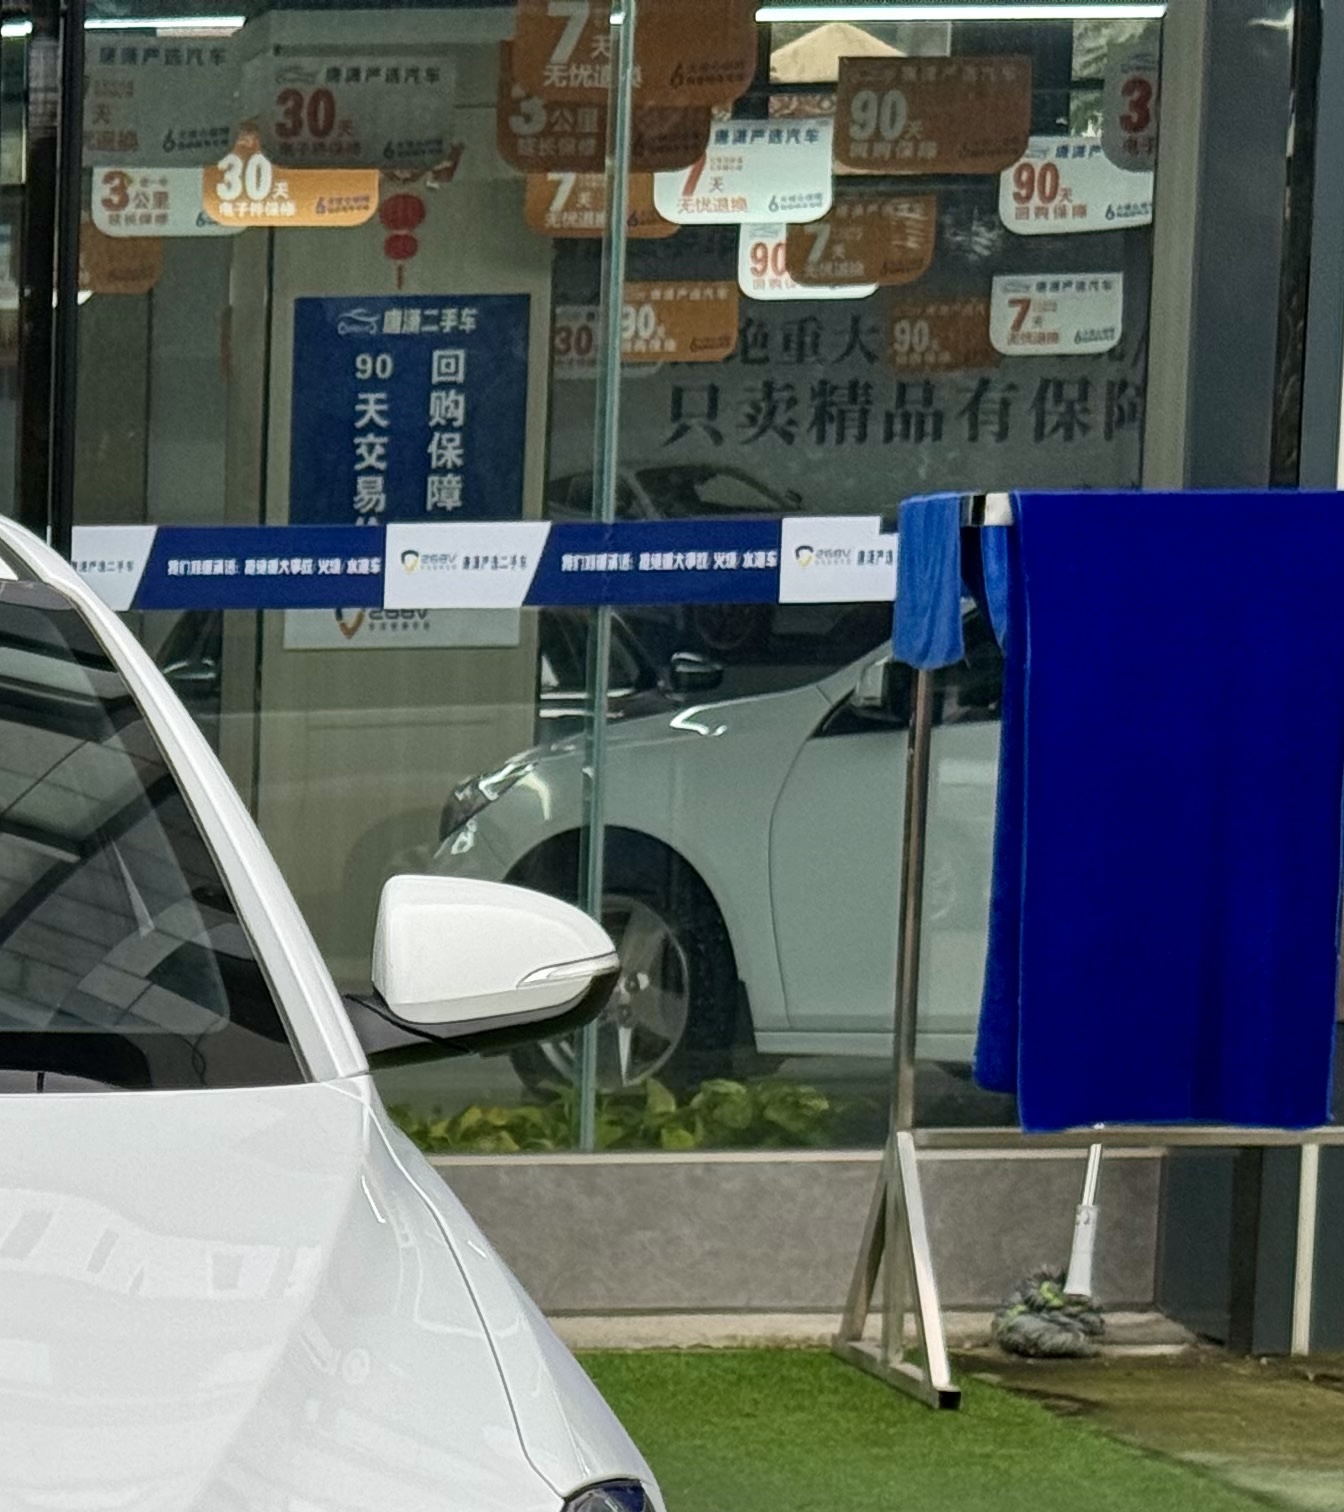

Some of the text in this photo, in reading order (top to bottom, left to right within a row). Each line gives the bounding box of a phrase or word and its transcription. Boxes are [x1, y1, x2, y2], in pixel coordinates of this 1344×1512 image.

[670, 63, 685, 89] 6
[275, 88, 354, 139] 30天
[551, 109, 599, 133] 公里
[849, 89, 924, 142] 90天
[1119, 78, 1153, 134] 3
[163, 129, 175, 152] 6
[101, 170, 170, 211] 3 公里
[216, 152, 289, 201] 30天
[1013, 162, 1074, 205] 90天
[219, 202, 296, 217] 电子件保修
[678, 197, 748, 215] 无忧退换
[768, 195, 779, 212] 6
[1015, 204, 1088, 221] 回购保障
[1105, 204, 1115, 221] 6
[353, 352, 394, 526] 90天交易
[426, 349, 466, 512] 回购保障
